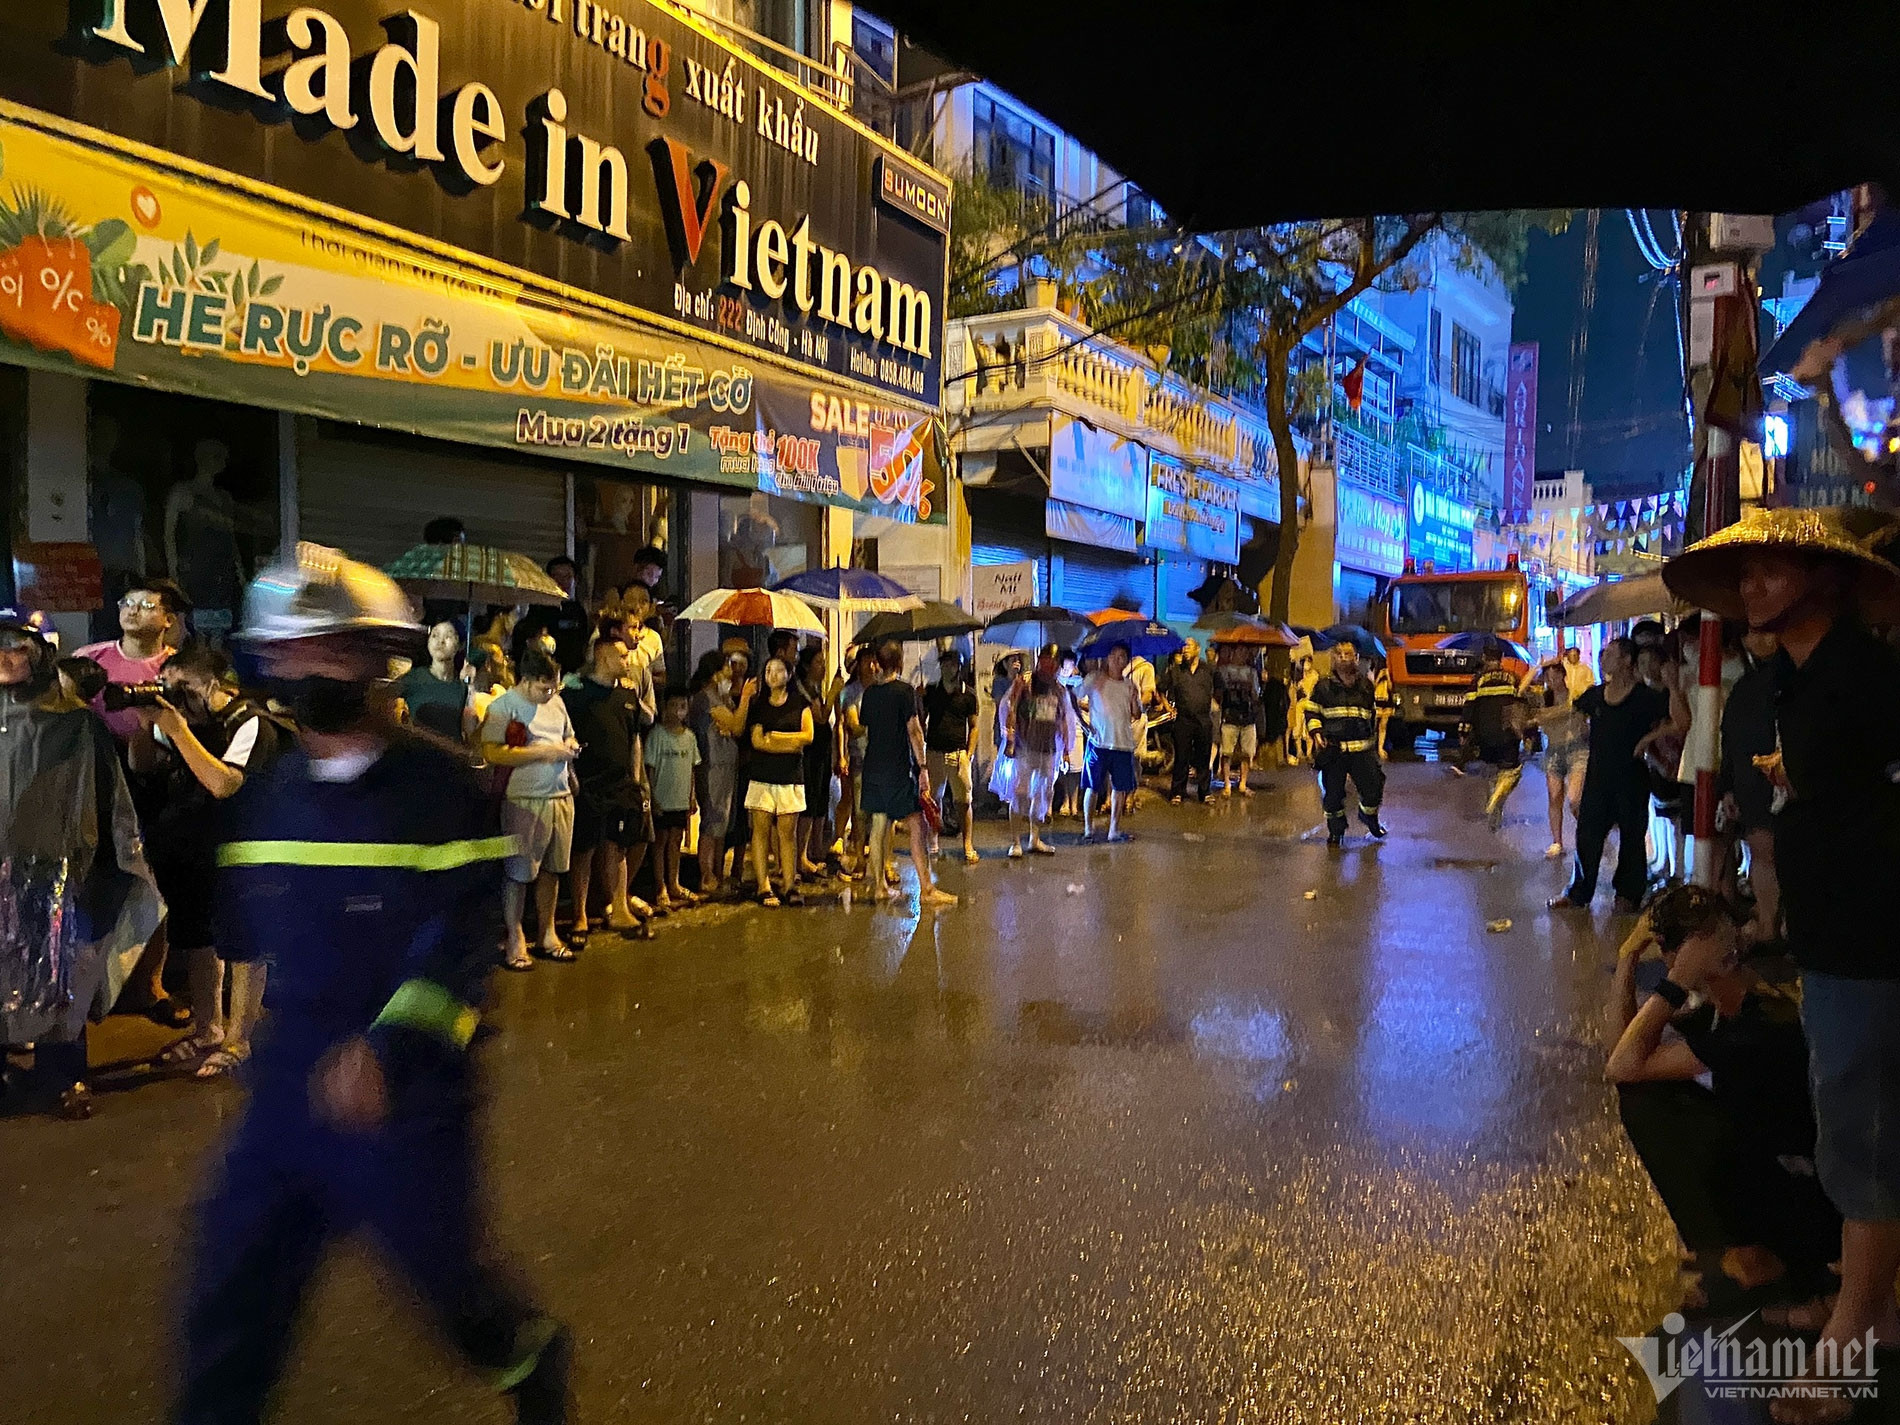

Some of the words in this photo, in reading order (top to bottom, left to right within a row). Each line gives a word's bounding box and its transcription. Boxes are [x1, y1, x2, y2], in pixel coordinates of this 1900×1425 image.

[574, 0, 672, 118] trang
[685, 56, 745, 124] xuất
[757, 86, 819, 167] khẩu
[539, 87, 631, 242] in
[663, 135, 932, 360] Vietnam
[884, 167, 946, 223] SUMOON
[241, 302, 363, 376] RỰC
[376, 318, 451, 378] RỠ
[489, 336, 553, 389] ƯU
[560, 342, 631, 399] ĐÃI
[674, 283, 692, 318] Địa
[719, 294, 742, 333] 222
[745, 309, 766, 343] Định
[768, 314, 790, 354] Công
[815, 335, 829, 367] Nội
[516, 408, 584, 446] Mua
[587, 414, 603, 448] 2
[609, 415, 675, 459] tặng
[676, 422, 690, 454] 1
[811, 390, 870, 437] SALE
[709, 425, 751, 456] Tặng
[776, 434, 821, 475] 100K
